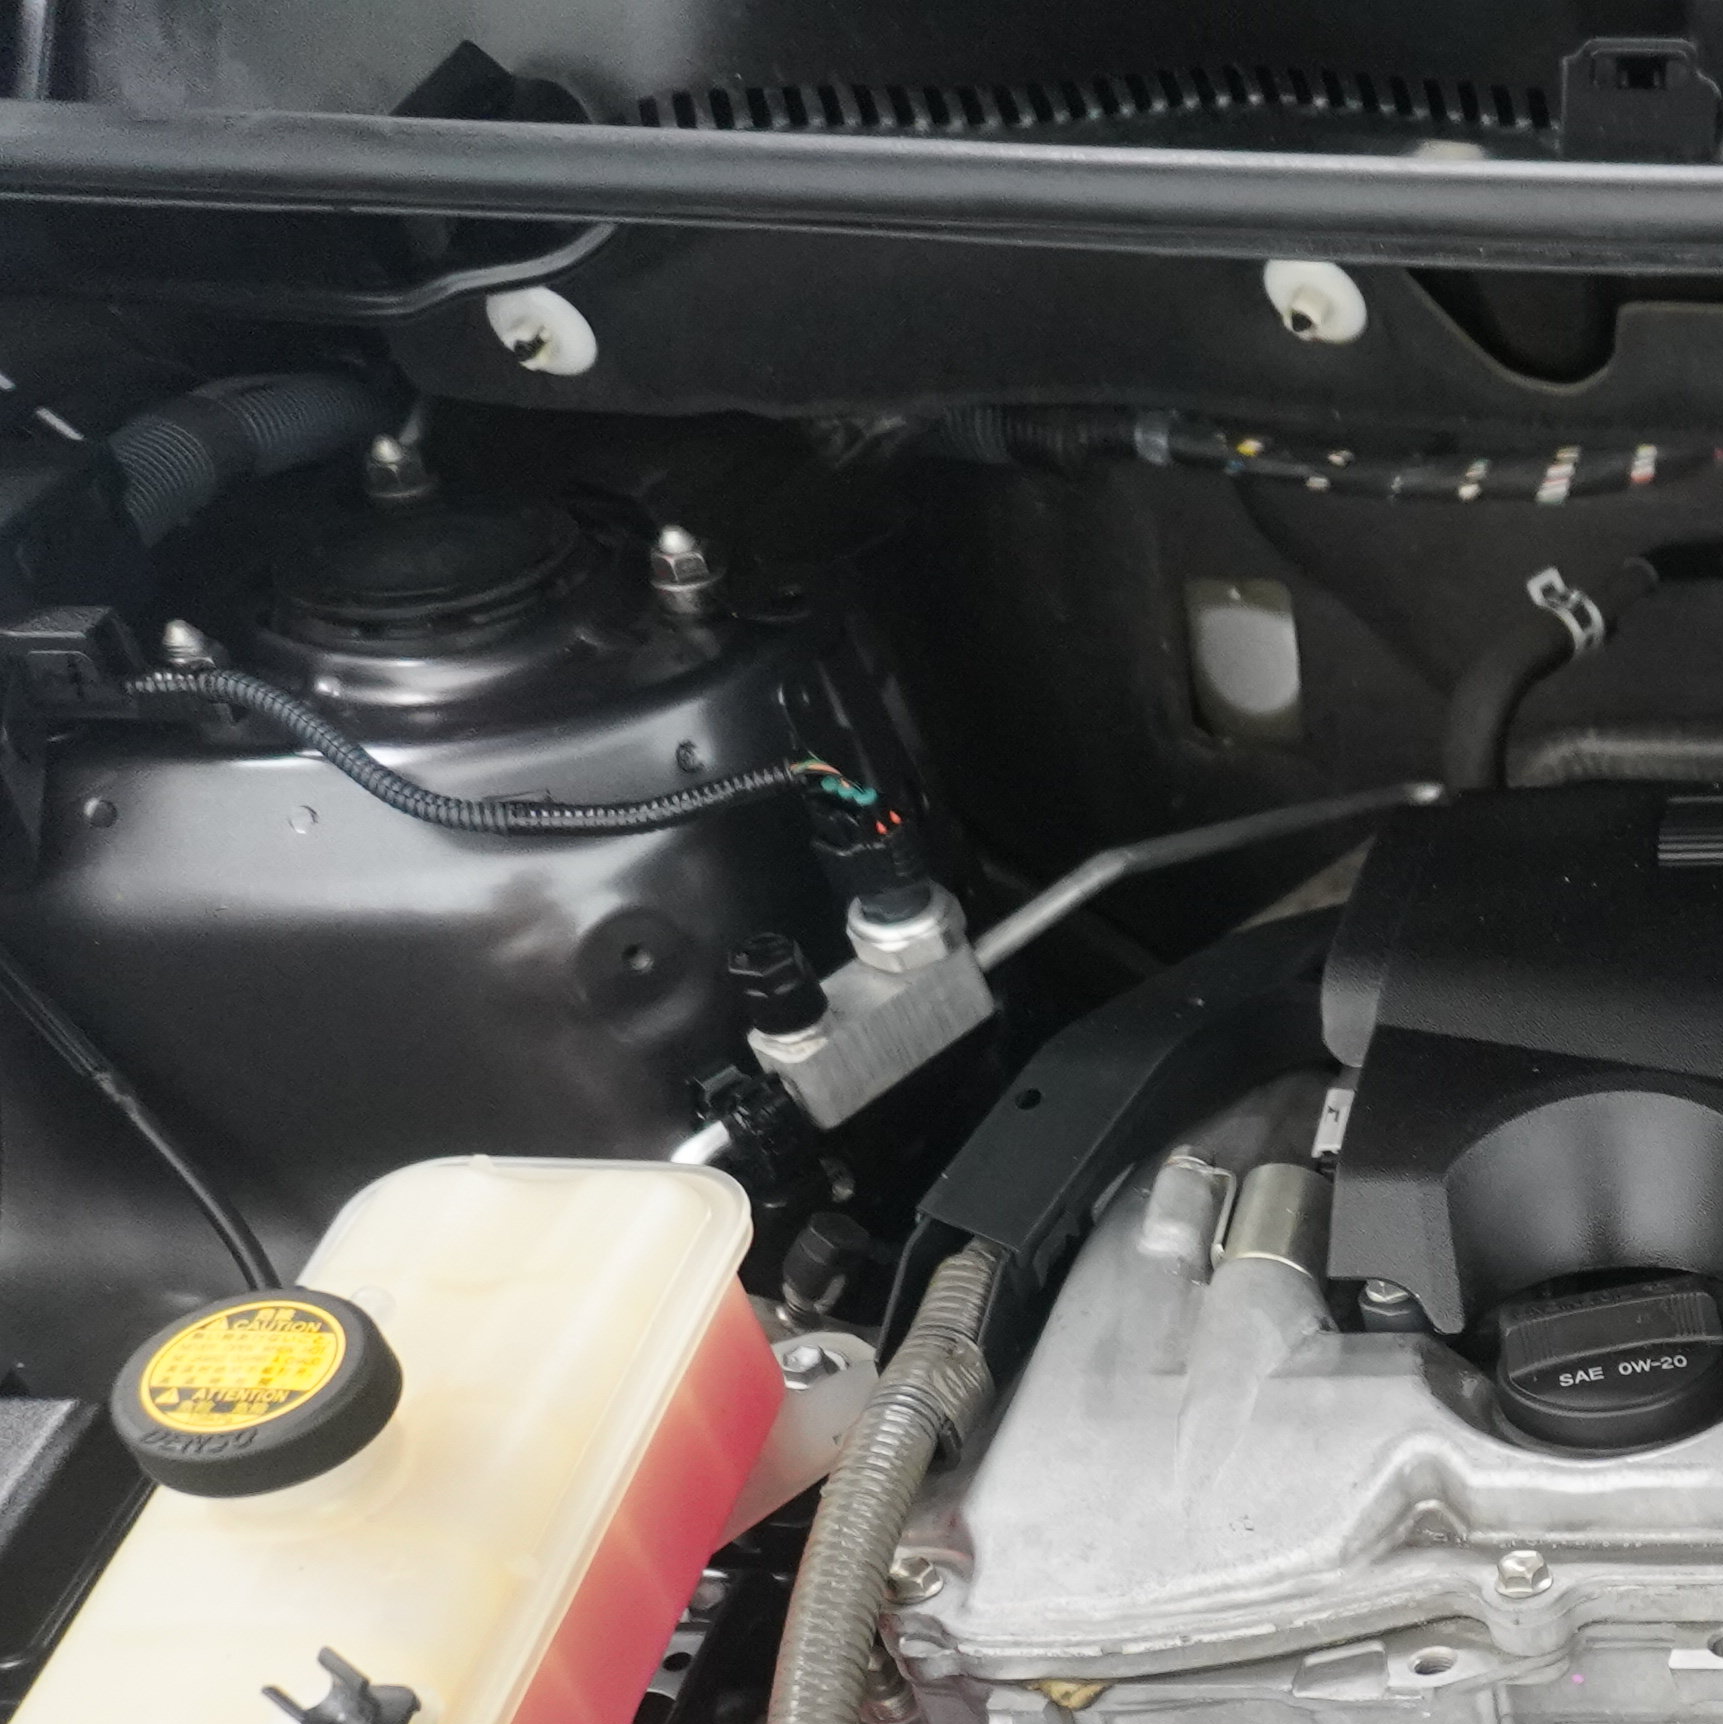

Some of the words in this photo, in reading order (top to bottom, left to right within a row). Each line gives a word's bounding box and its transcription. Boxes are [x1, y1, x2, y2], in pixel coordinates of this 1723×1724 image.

[232, 1319, 322, 1333] CAUTION
[1559, 1366, 1605, 1387] SAE
[1618, 1354, 1688, 1376] 0W-20
[191, 1388, 290, 1403] ATTENTION
